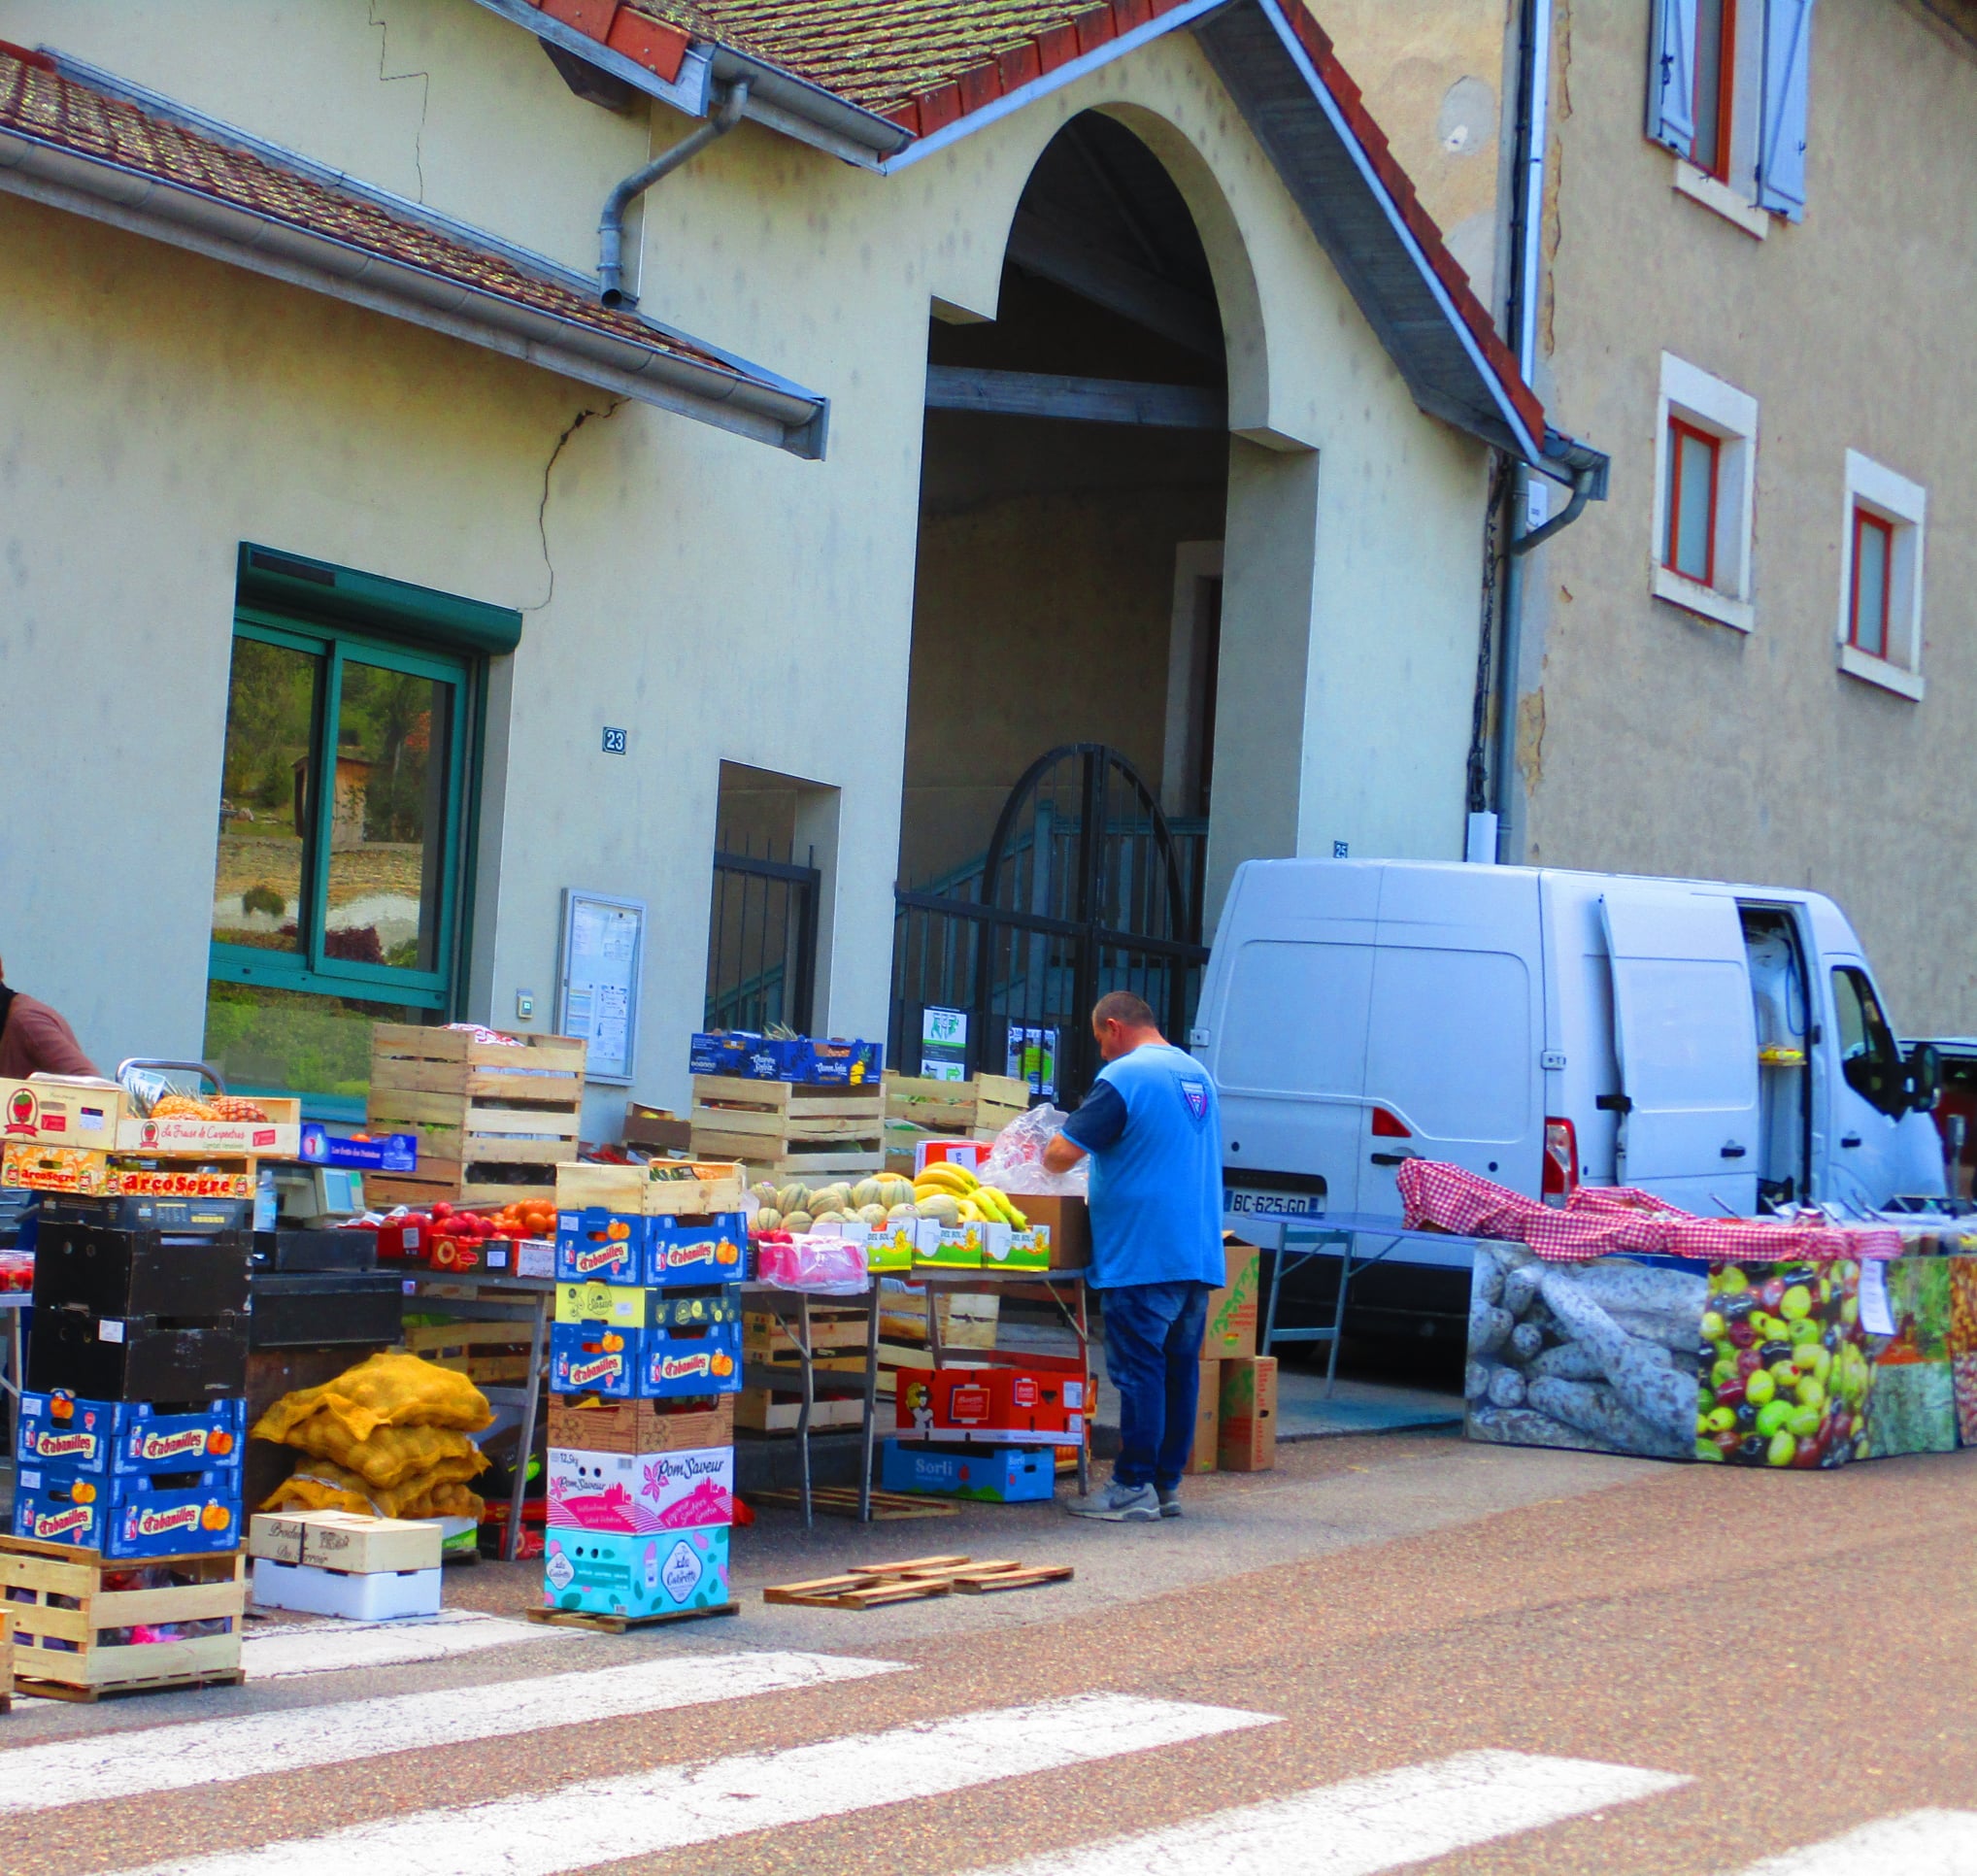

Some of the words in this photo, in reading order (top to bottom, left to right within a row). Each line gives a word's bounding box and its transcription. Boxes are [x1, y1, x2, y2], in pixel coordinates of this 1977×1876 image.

[607, 731, 624, 751] 23
[124, 1173, 230, 1194] arcoSegre
[916, 1457, 953, 1476] Sorli
